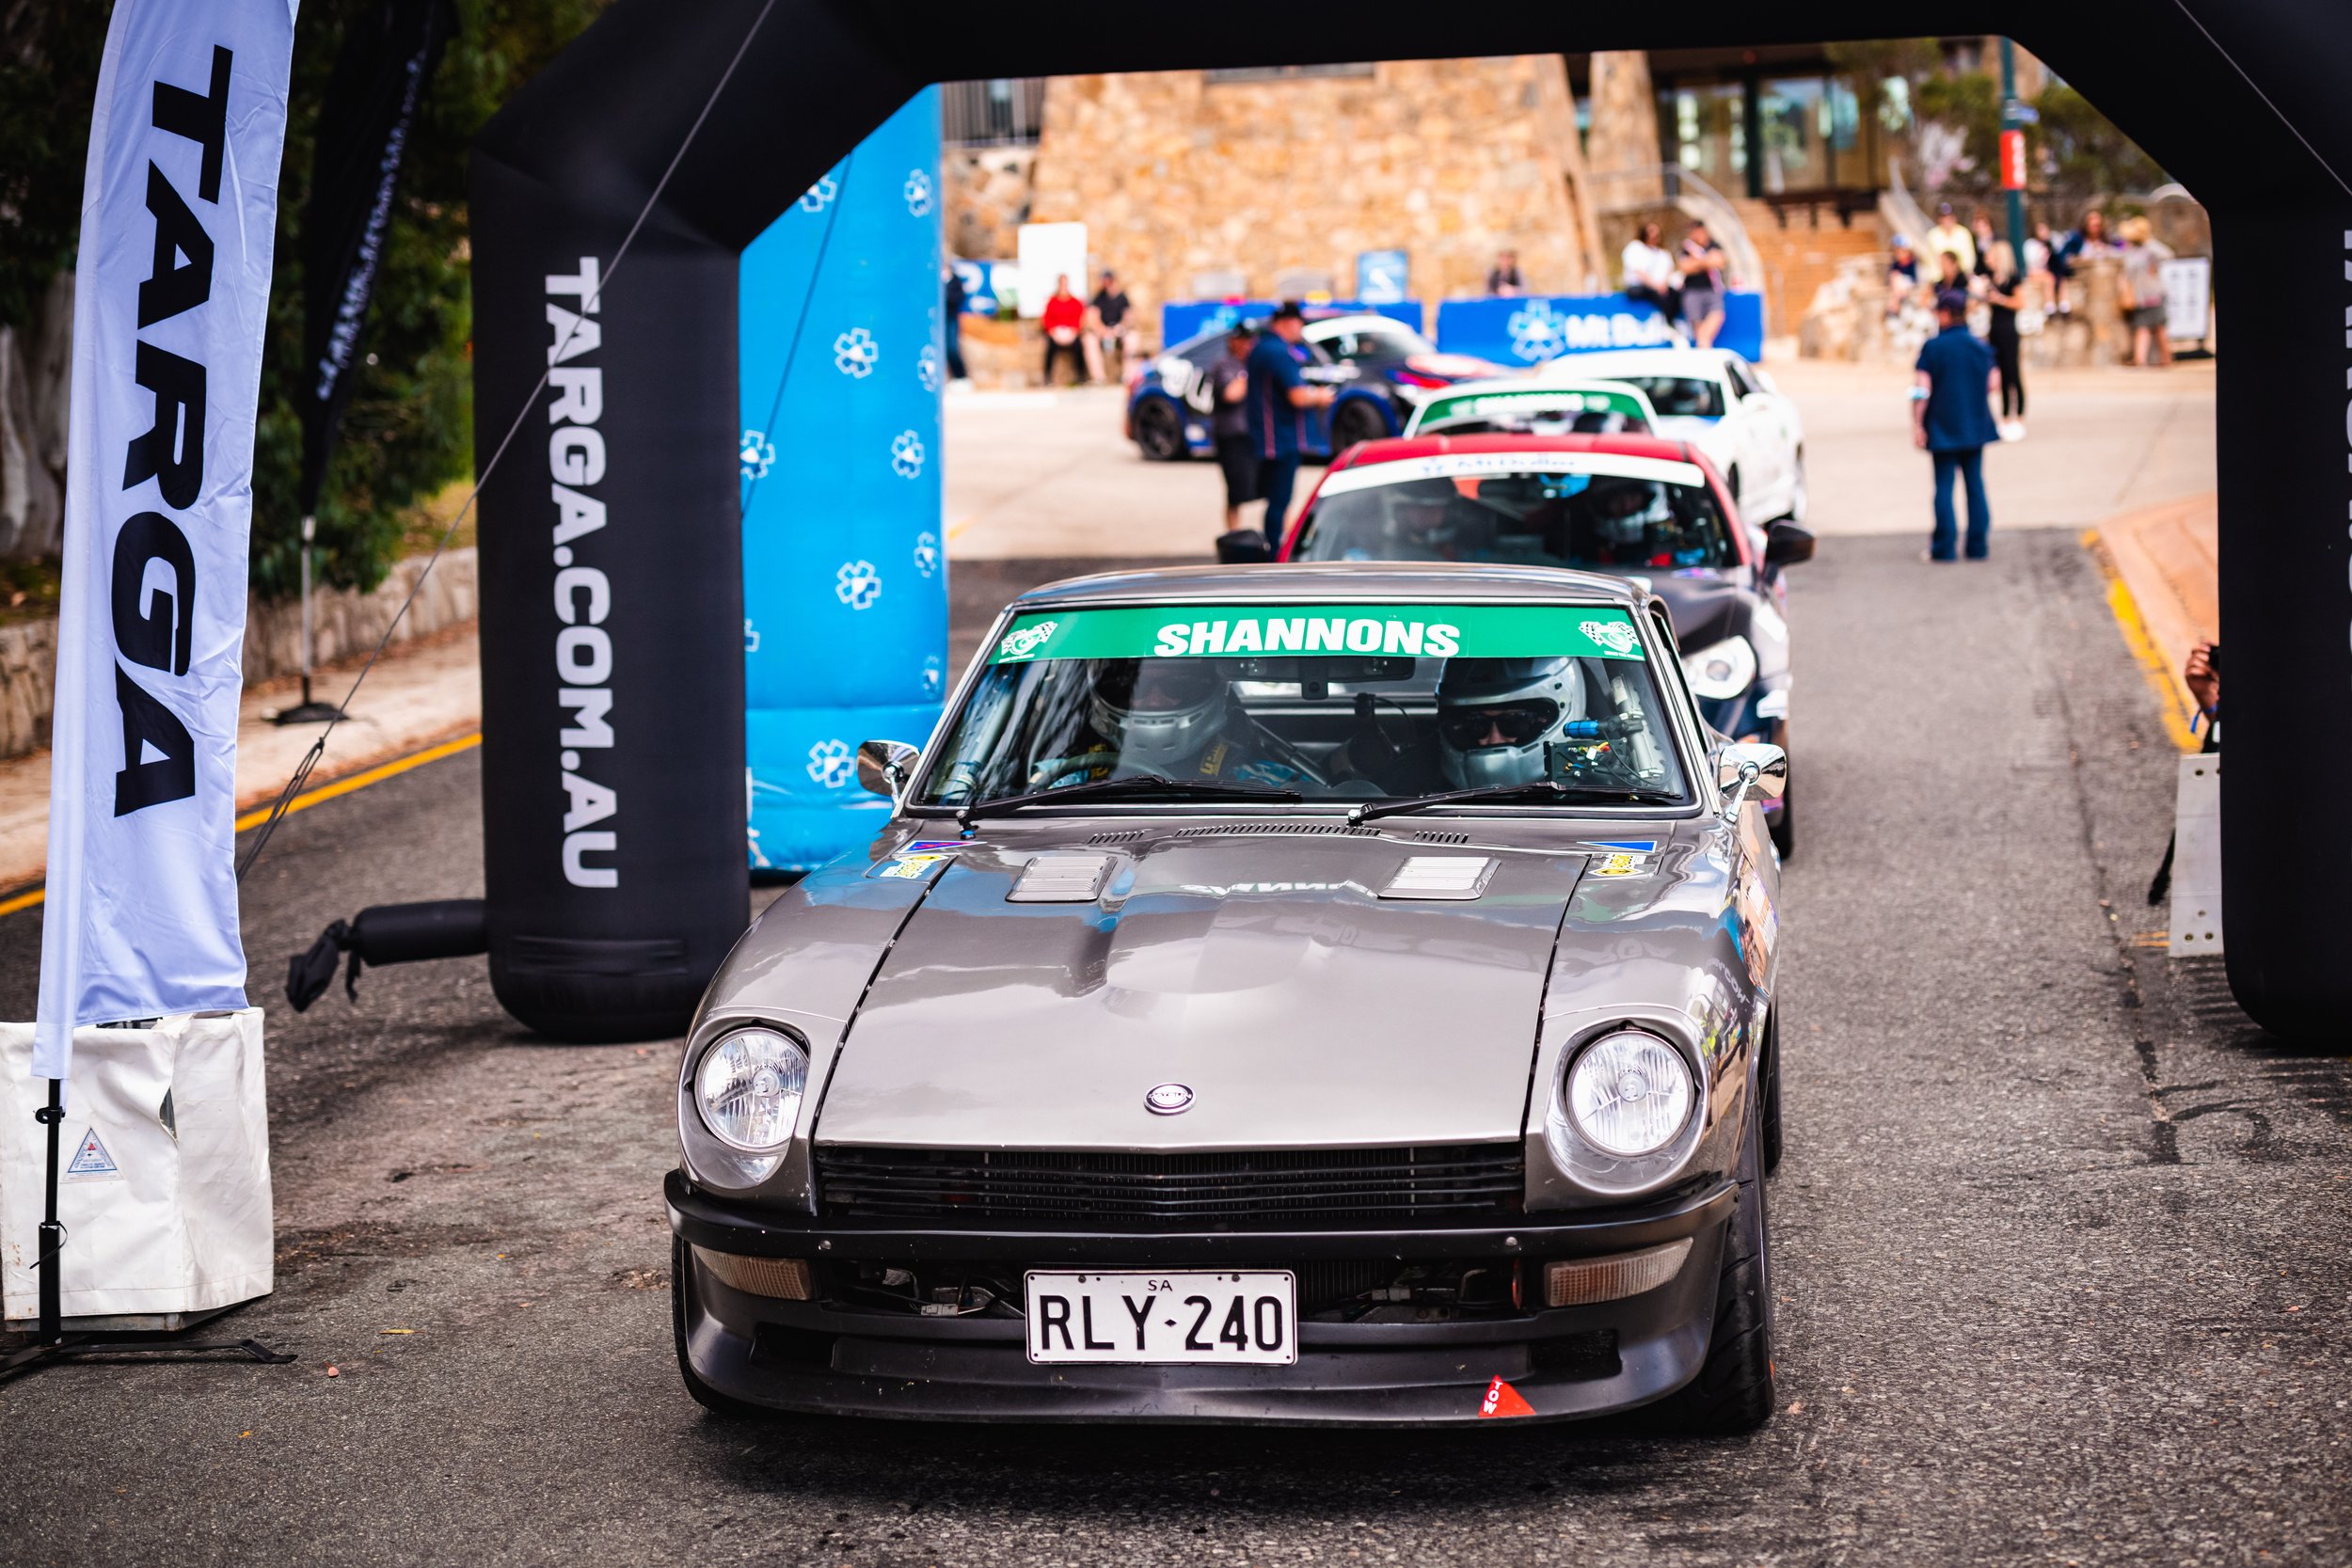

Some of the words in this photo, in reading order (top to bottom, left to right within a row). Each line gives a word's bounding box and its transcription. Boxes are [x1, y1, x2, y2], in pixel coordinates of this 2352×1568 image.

[111, 44, 233, 818] TARGA
[546, 257, 618, 889] TARGA.COM.AU
[1153, 618, 1461, 657] SHANNONS
[1147, 1279, 1173, 1292] SA
[1483, 1381, 1503, 1415] TOW
